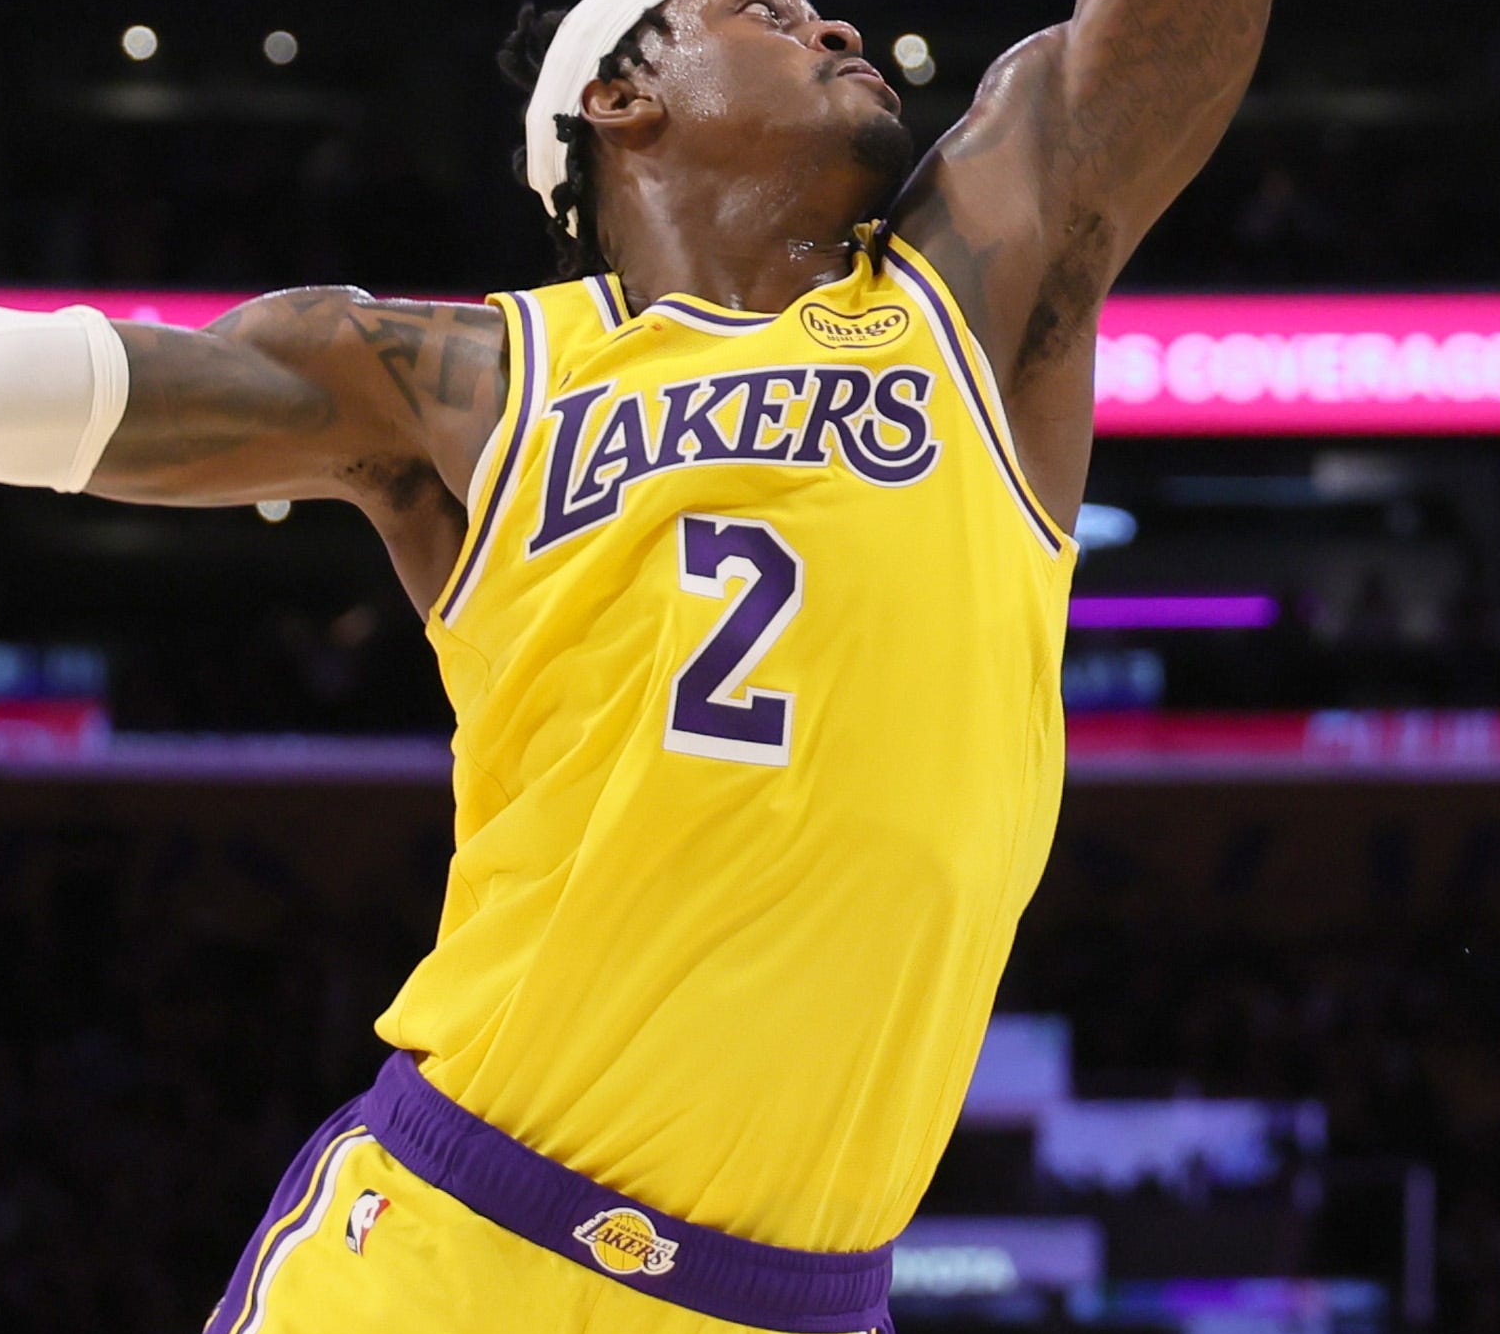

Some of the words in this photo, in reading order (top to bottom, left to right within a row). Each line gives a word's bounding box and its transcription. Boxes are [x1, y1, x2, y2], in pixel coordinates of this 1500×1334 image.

[808, 311, 901, 336] bibigo
[523, 364, 943, 561] LAKERS
[662, 511, 804, 767] 2
[580, 1216, 673, 1272] LAKERS
